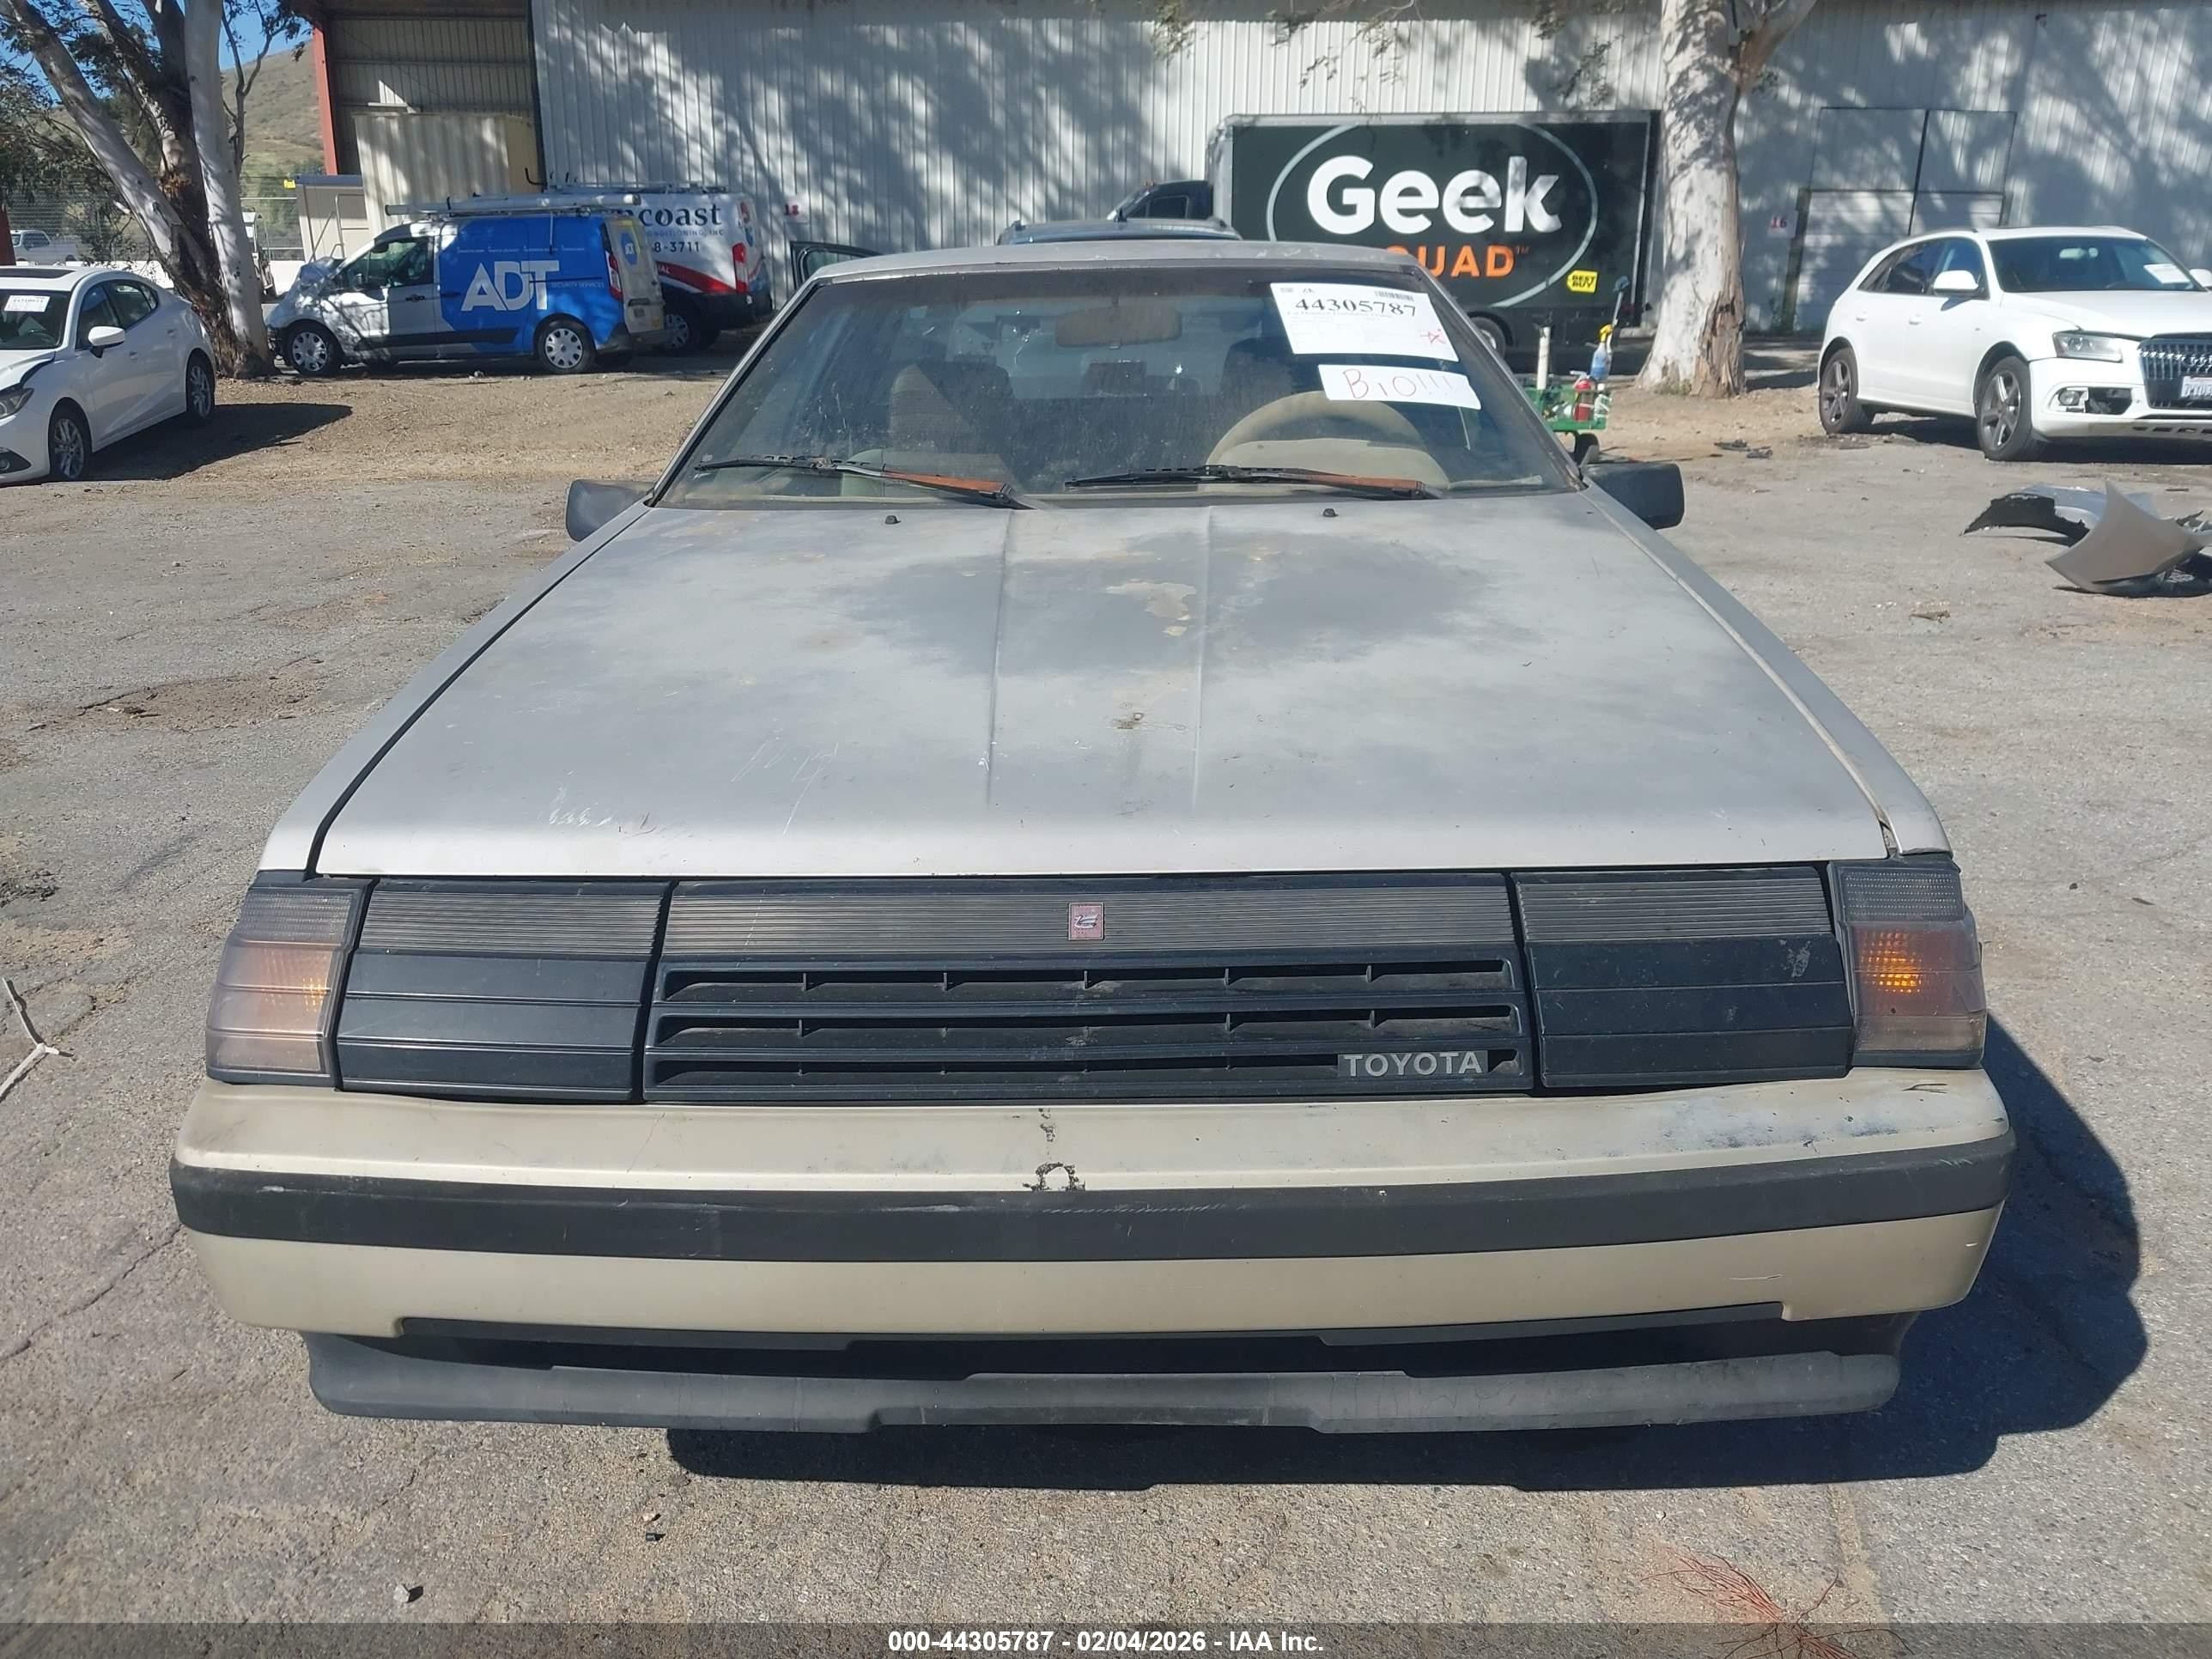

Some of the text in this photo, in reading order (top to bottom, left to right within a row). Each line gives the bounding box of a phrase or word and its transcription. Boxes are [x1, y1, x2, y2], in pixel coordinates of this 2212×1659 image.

[1307, 155, 1563, 234] Geek
[617, 203, 722, 227] coast
[653, 241, 699, 253] 8-3711
[1386, 245, 1516, 278] UAD
[460, 260, 559, 312] ADT
[1295, 299, 1416, 317] 44305787
[1344, 1051, 1484, 1077] TOYOTA
